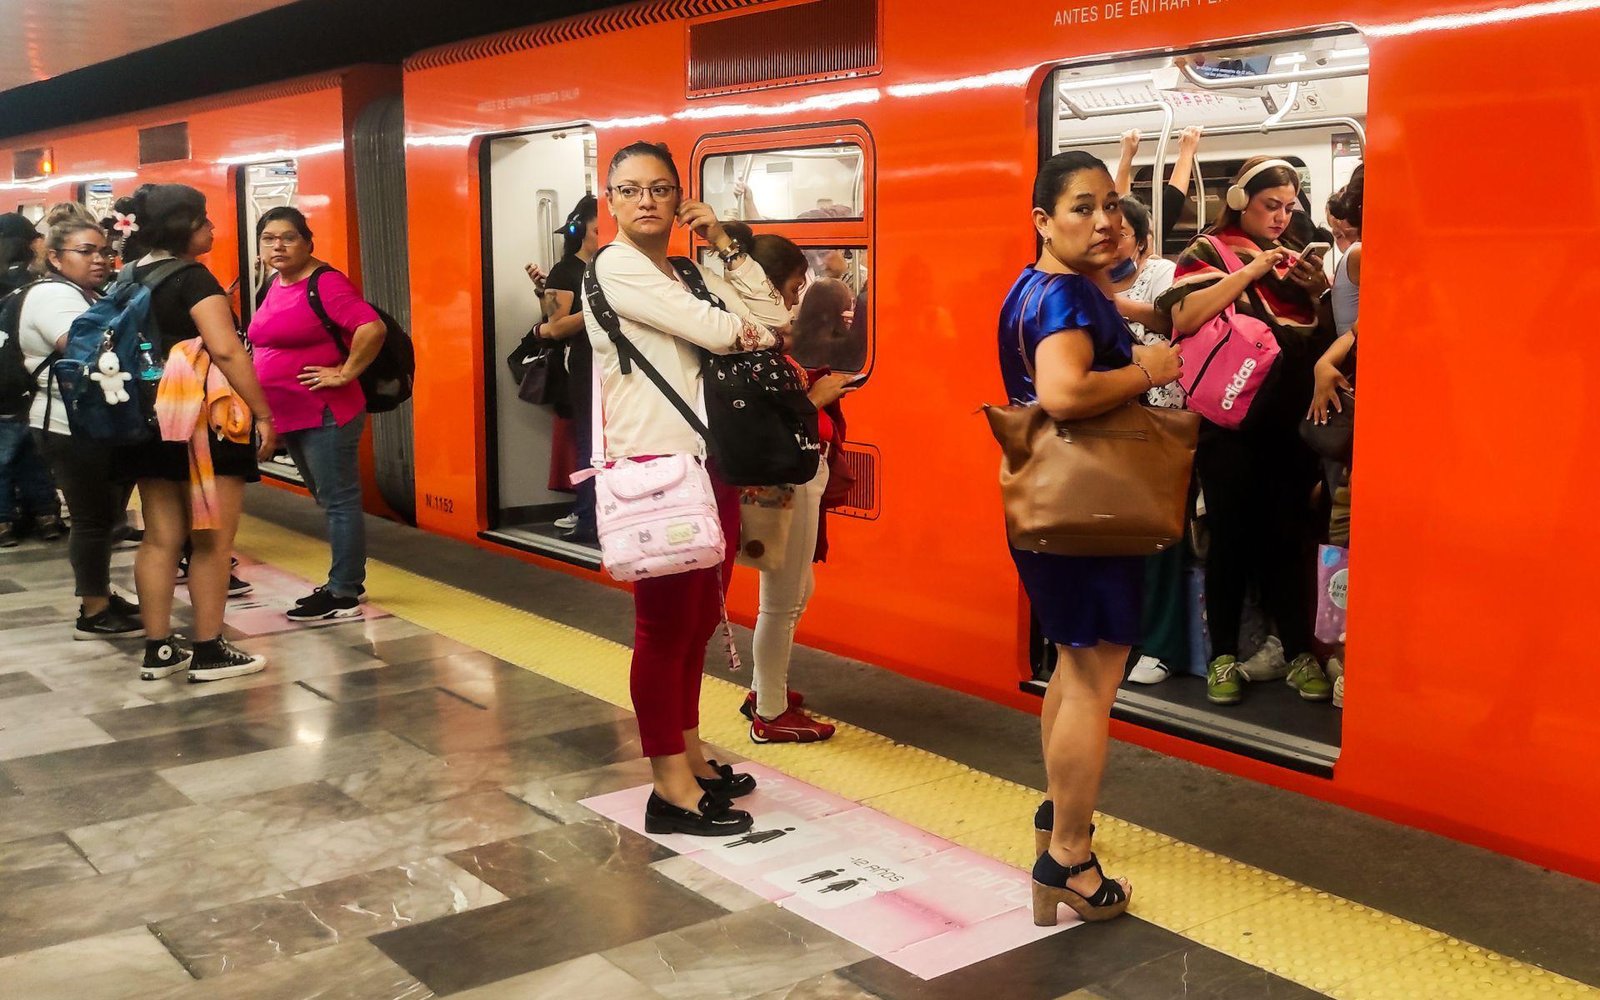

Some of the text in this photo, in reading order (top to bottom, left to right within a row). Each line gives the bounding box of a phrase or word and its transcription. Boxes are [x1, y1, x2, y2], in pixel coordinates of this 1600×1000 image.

[1054, 6, 1098, 26] ANTES
[1105, 2, 1124, 19] DE
[1222, 357, 1257, 410] adidas
